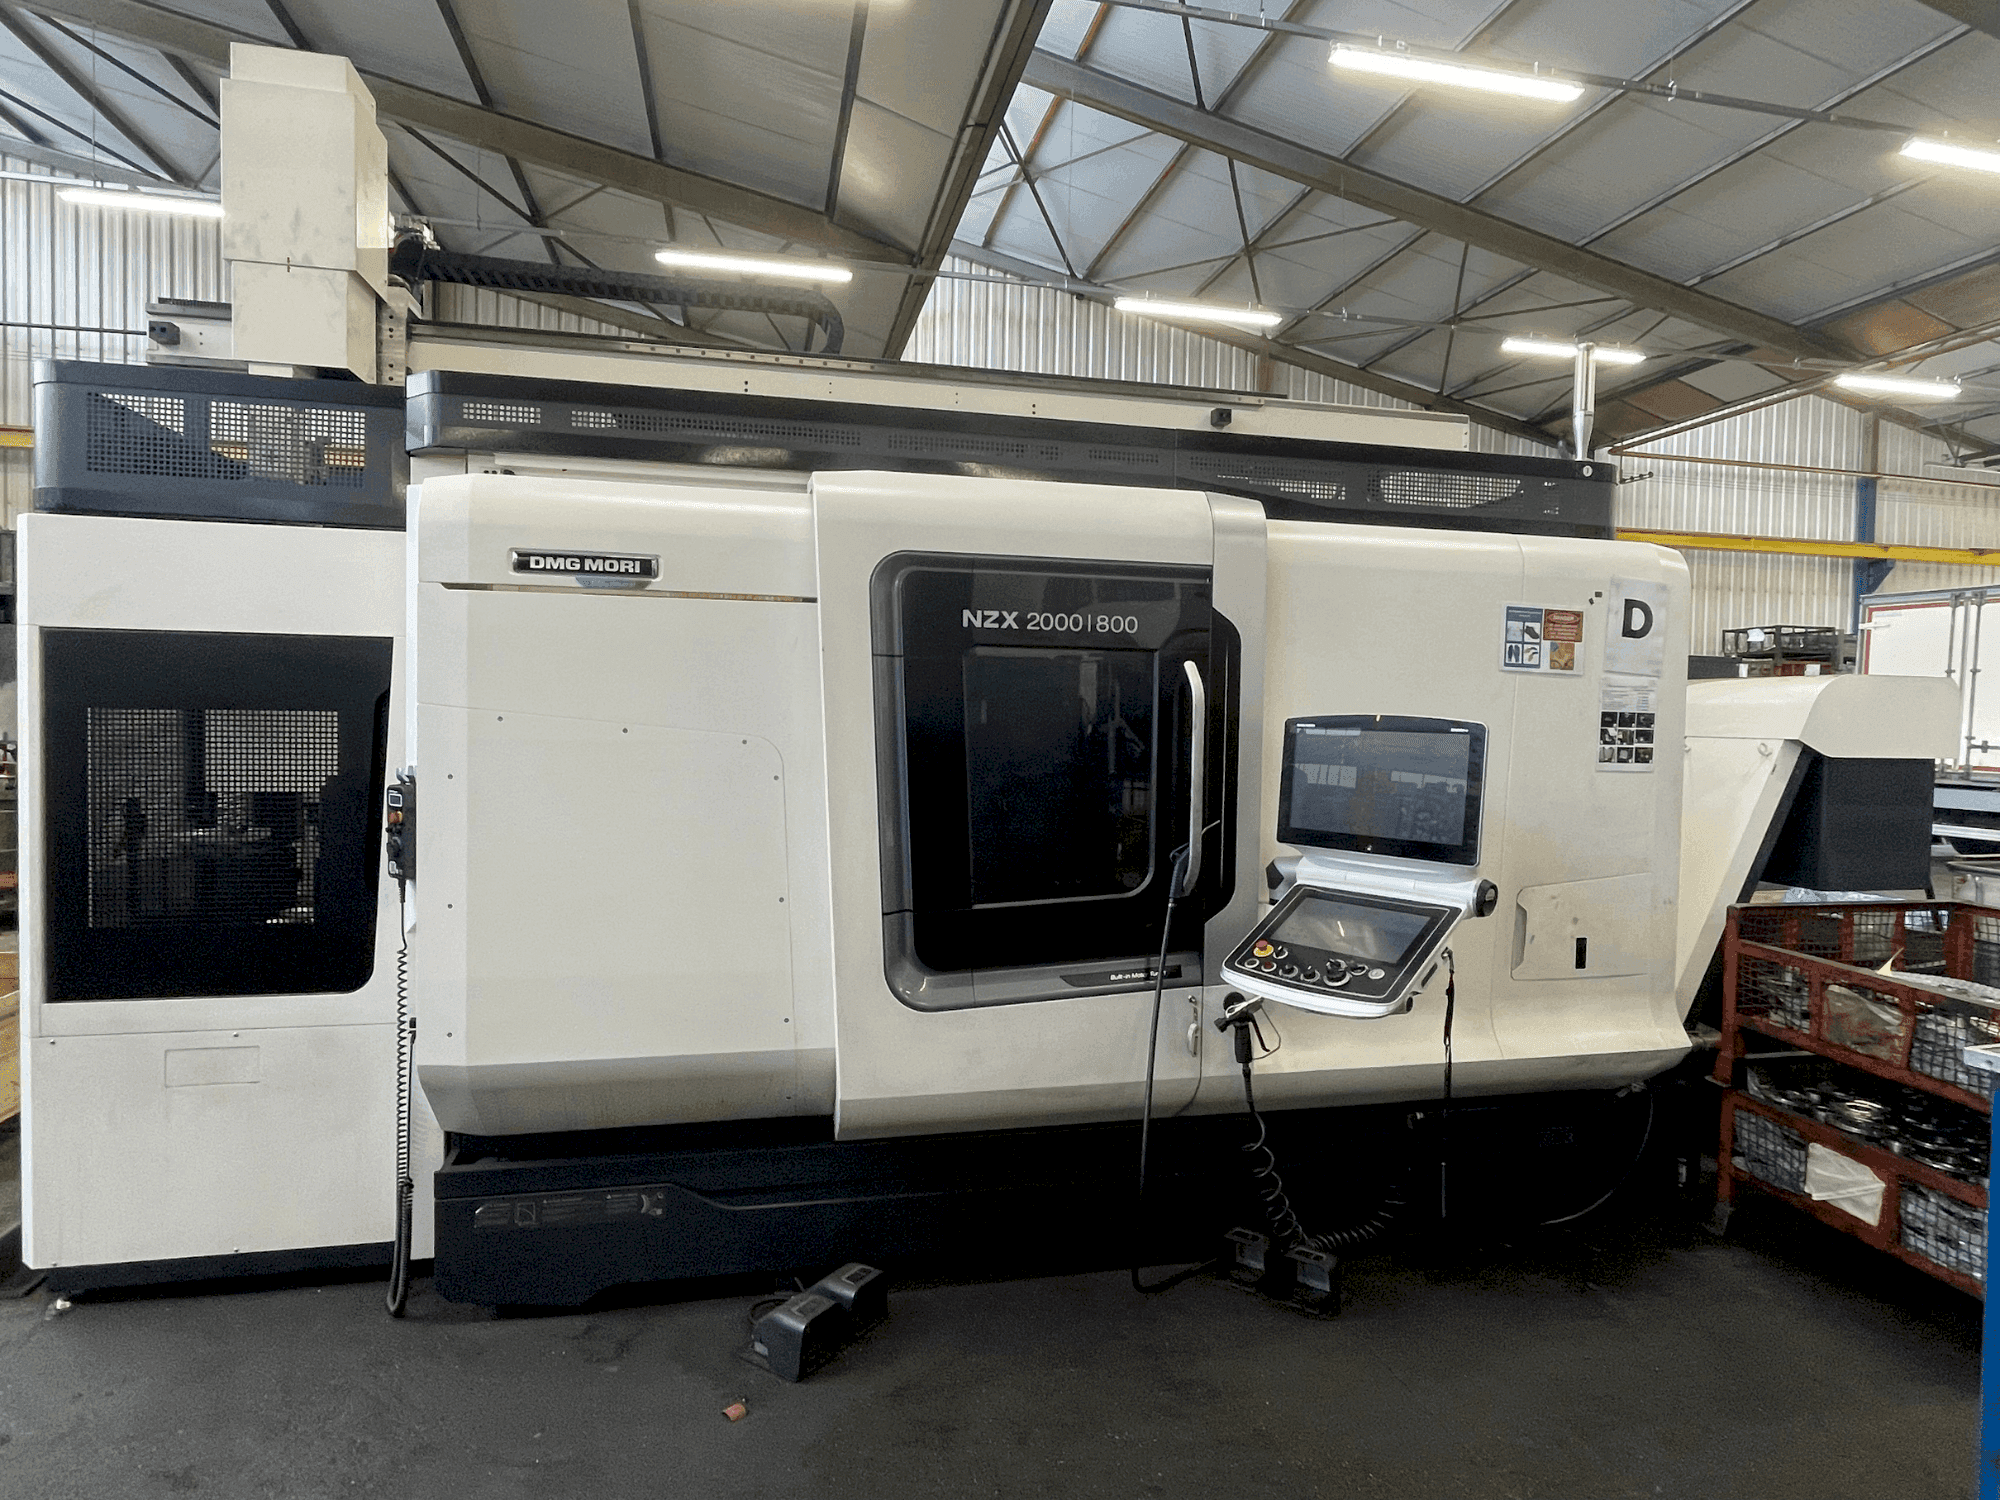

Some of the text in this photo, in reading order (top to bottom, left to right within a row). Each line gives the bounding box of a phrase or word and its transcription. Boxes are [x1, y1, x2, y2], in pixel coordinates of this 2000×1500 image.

[529, 555, 641, 573] DMG MORI
[962, 609, 1019, 630] NZX
[1622, 598, 1654, 639] D
